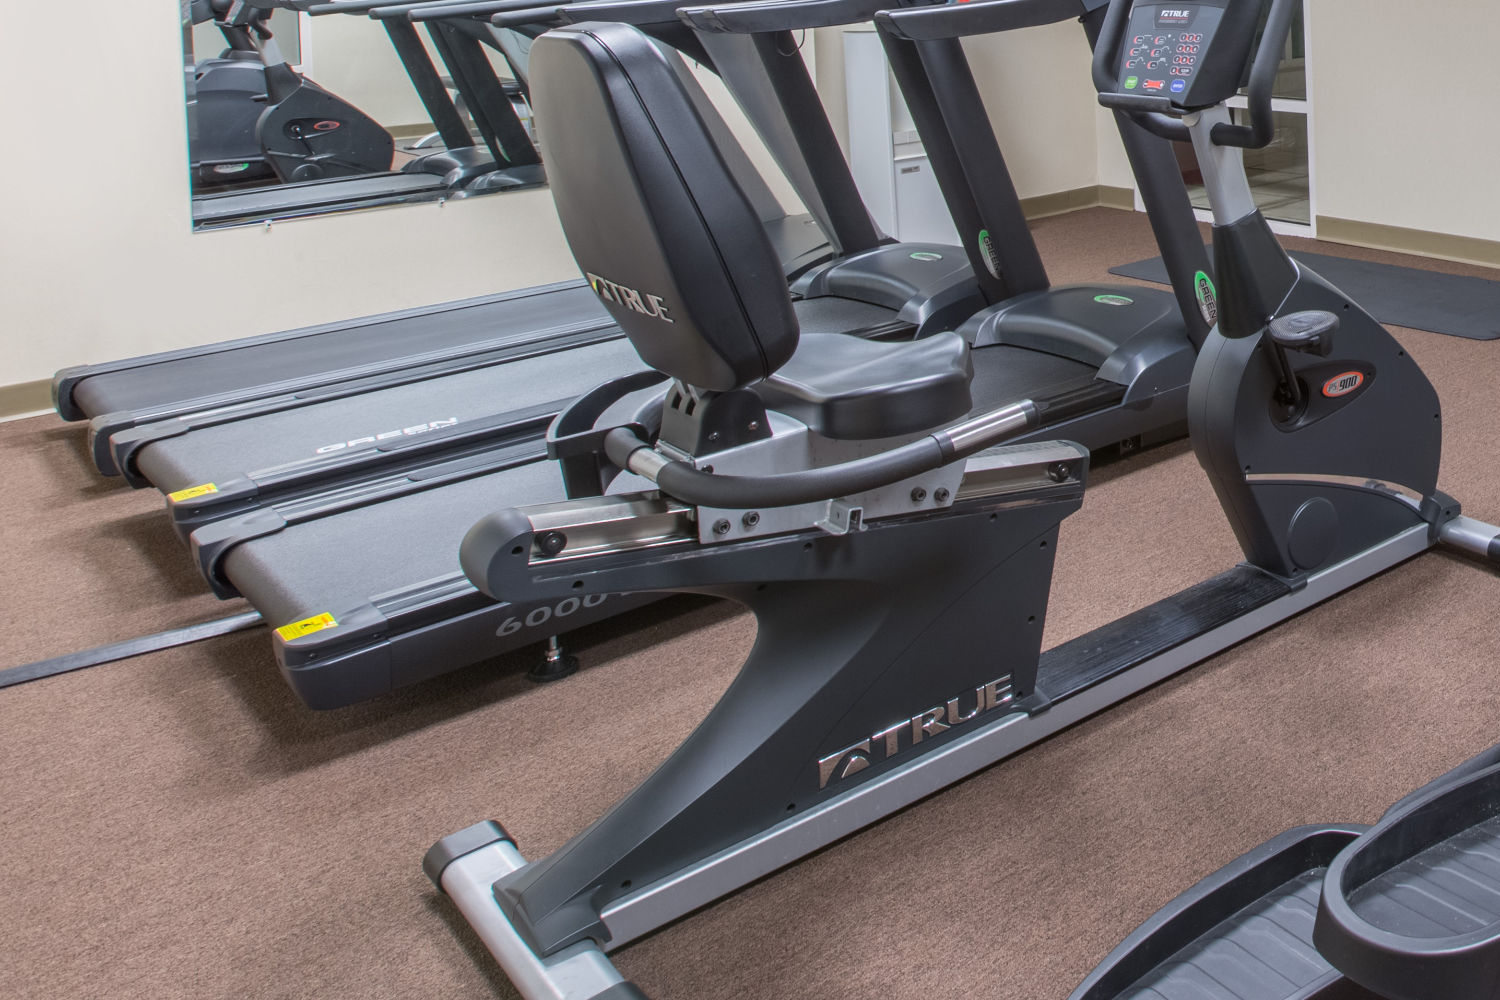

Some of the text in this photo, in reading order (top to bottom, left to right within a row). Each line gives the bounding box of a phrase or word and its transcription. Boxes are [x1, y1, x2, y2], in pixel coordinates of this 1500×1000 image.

[605, 280, 674, 324] TRUE
[1200, 278, 1217, 318] GREEN
[1339, 375, 1357, 392] 900
[496, 592, 608, 637] 6000
[872, 674, 1012, 758] TRUE
